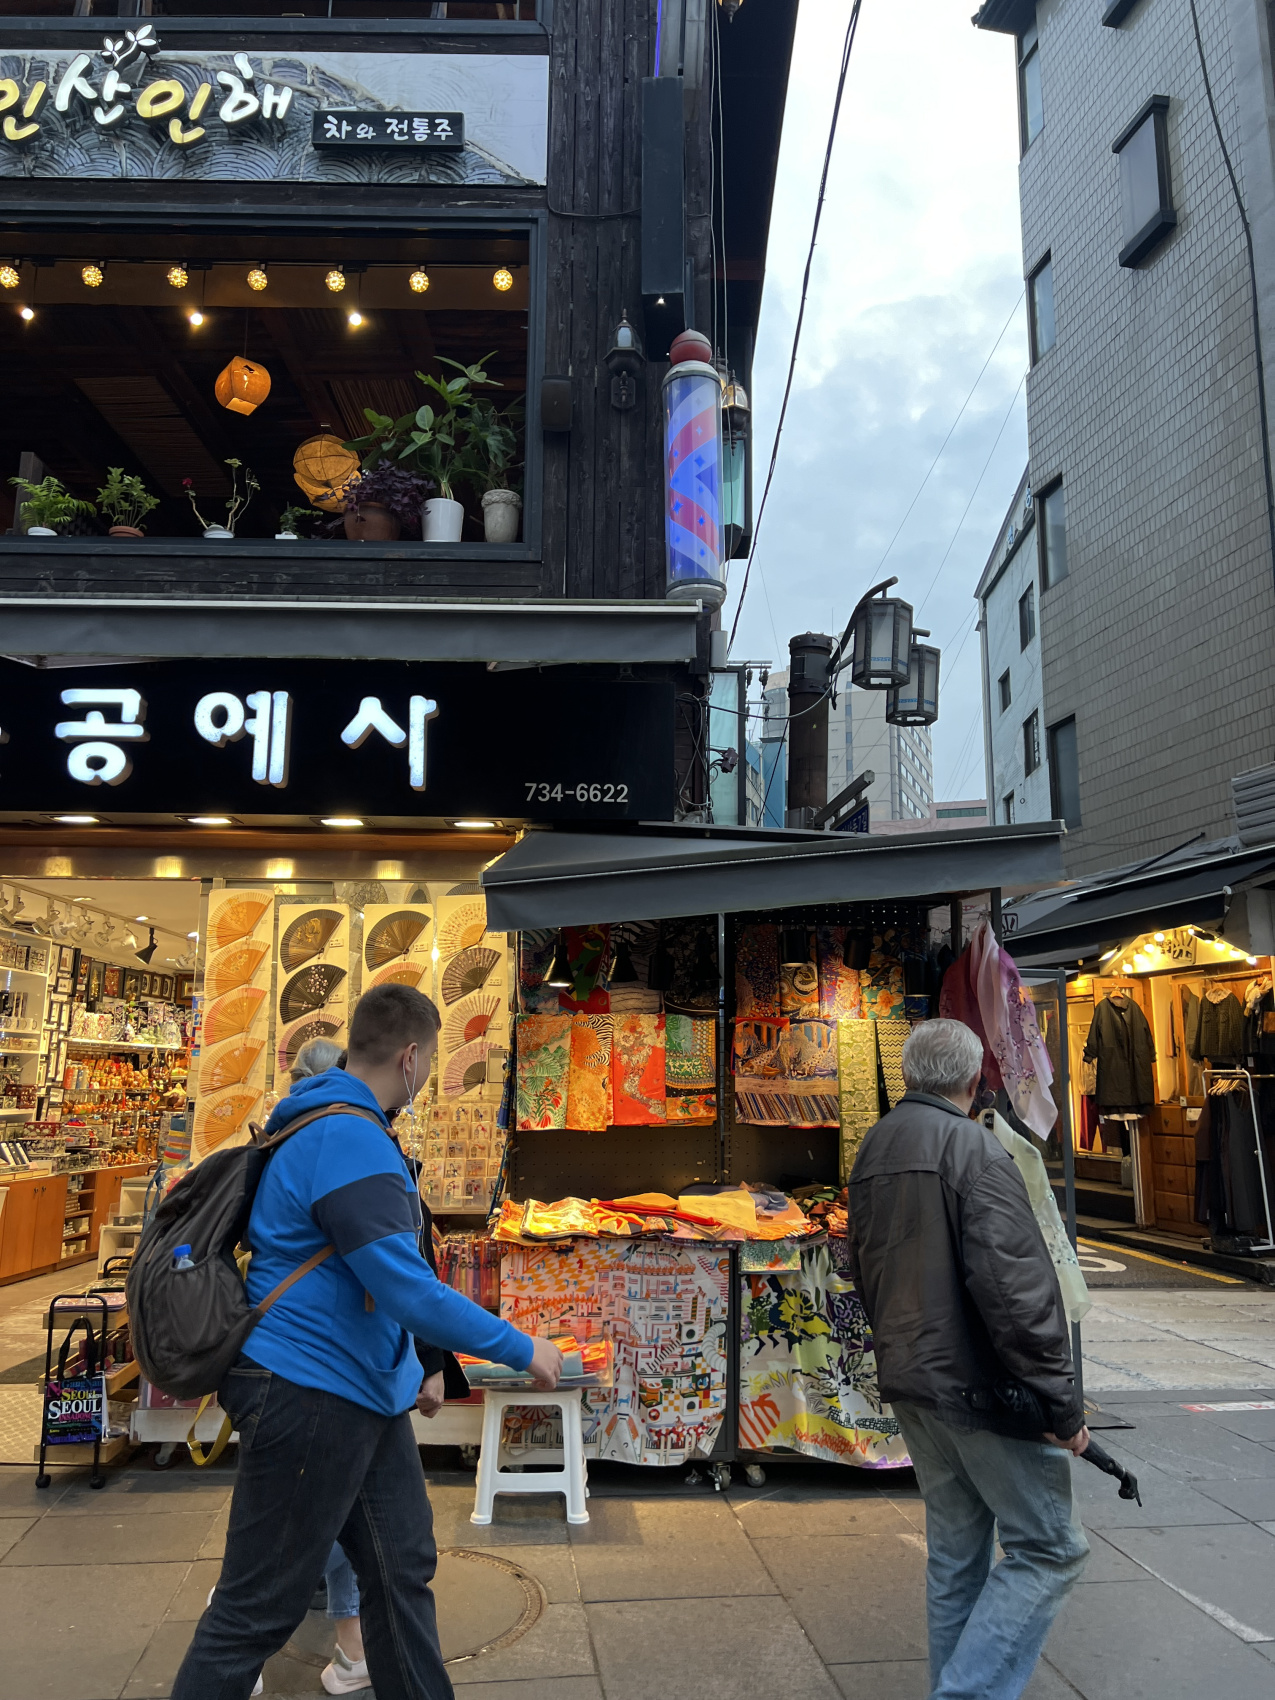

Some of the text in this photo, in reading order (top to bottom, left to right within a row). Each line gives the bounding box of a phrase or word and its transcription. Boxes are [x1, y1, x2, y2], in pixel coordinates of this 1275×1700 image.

[384, 117, 454, 142] 전통주
[525, 783, 629, 803] 734-6622
[48, 1399, 101, 1420] SEOUL
